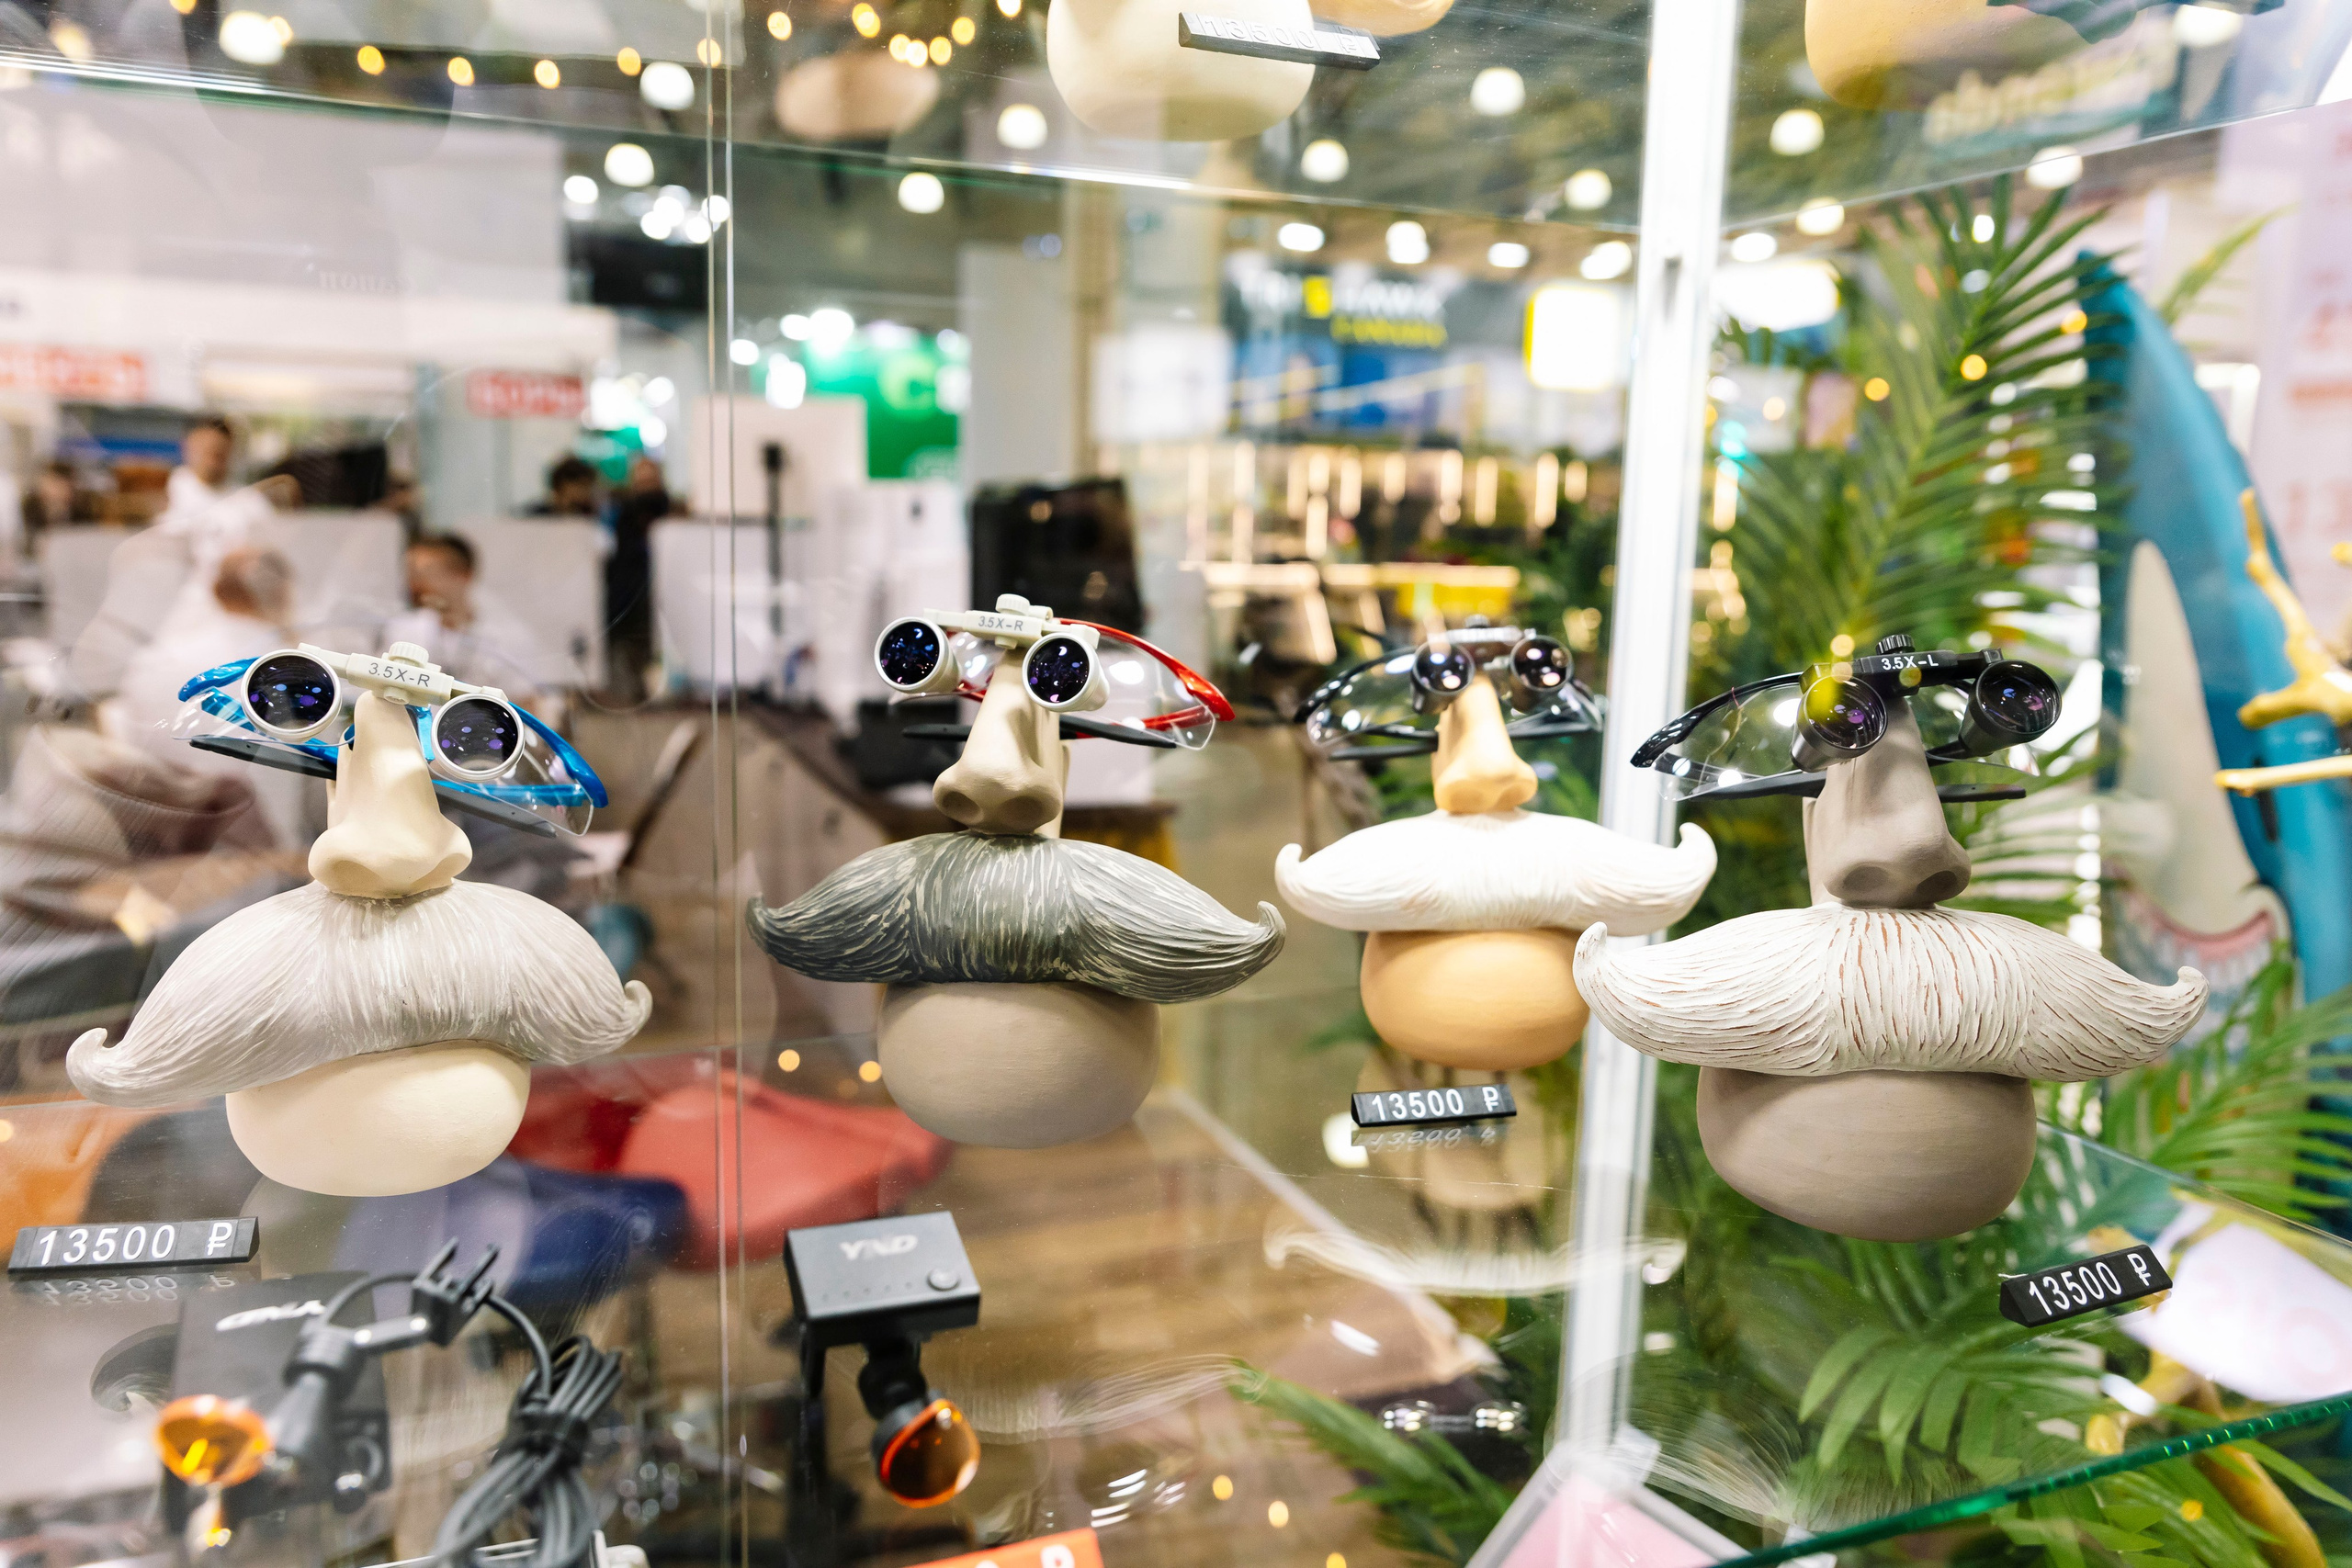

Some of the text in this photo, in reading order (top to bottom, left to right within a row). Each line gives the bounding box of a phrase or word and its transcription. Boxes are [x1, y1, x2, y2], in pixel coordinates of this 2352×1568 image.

[1204, 19, 1317, 49] 13500
[978, 615, 1023, 632] 3.5X-R
[368, 662, 430, 688] 3.5X-R
[1881, 654, 1939, 671] 3.5X-L
[1372, 1089, 1464, 1121] 13500
[39, 1224, 175, 1265] 13500
[2029, 1261, 2121, 1316] 13500
